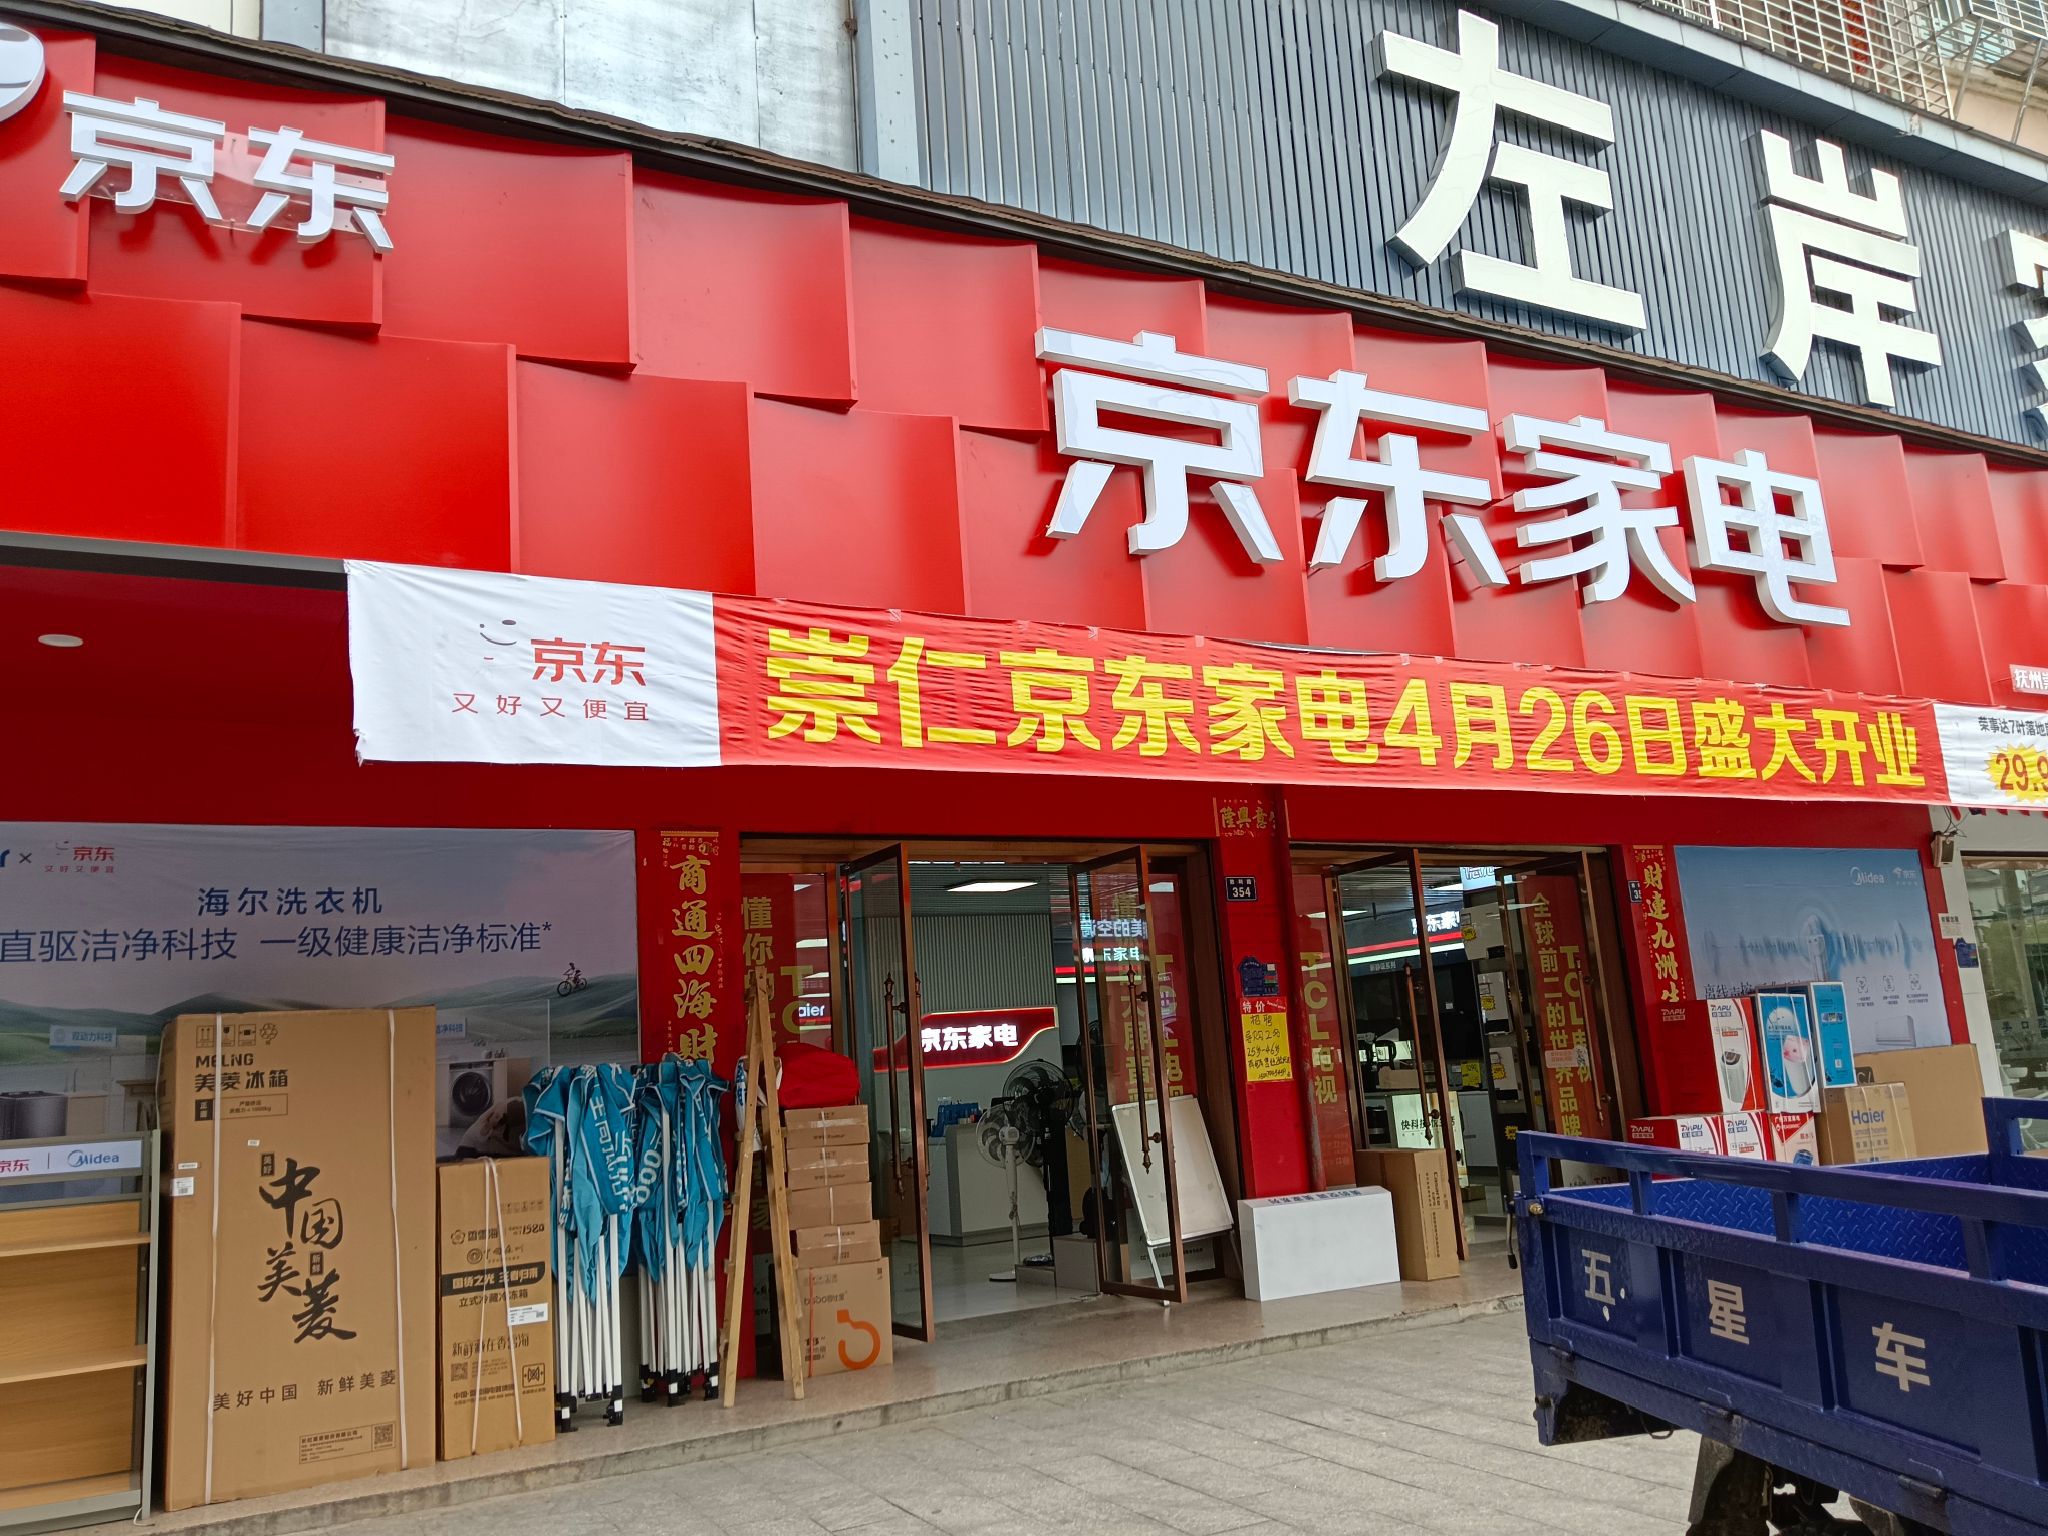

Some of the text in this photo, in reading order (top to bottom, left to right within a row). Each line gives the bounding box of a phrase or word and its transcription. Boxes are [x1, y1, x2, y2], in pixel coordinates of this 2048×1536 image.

[59, 91, 395, 254] 京东
[1036, 327, 1850, 627] 京东家电
[531, 637, 646, 686] 京东
[452, 692, 650, 721] 又好又便宜
[767, 627, 1926, 787] 崇仁京东家电4月26日盛大开业
[73, 846, 115, 861] 京东
[1849, 866, 1885, 886] Midea
[197, 886, 383, 917] 海尔洗衣机
[1232, 886, 1251, 898] 354
[0, 926, 237, 963] 直驱洁净科技
[798, 1004, 825, 1017] aier
[1242, 1000, 1266, 1013] 特价
[921, 1023, 1019, 1053] 京东家电
[195, 1069, 289, 1092] 美菱冰箱
[1851, 1107, 1885, 1126] Haier
[67, 1149, 120, 1168] Midea
[212, 1369, 397, 1412] 美好中国 新鲜美菱
